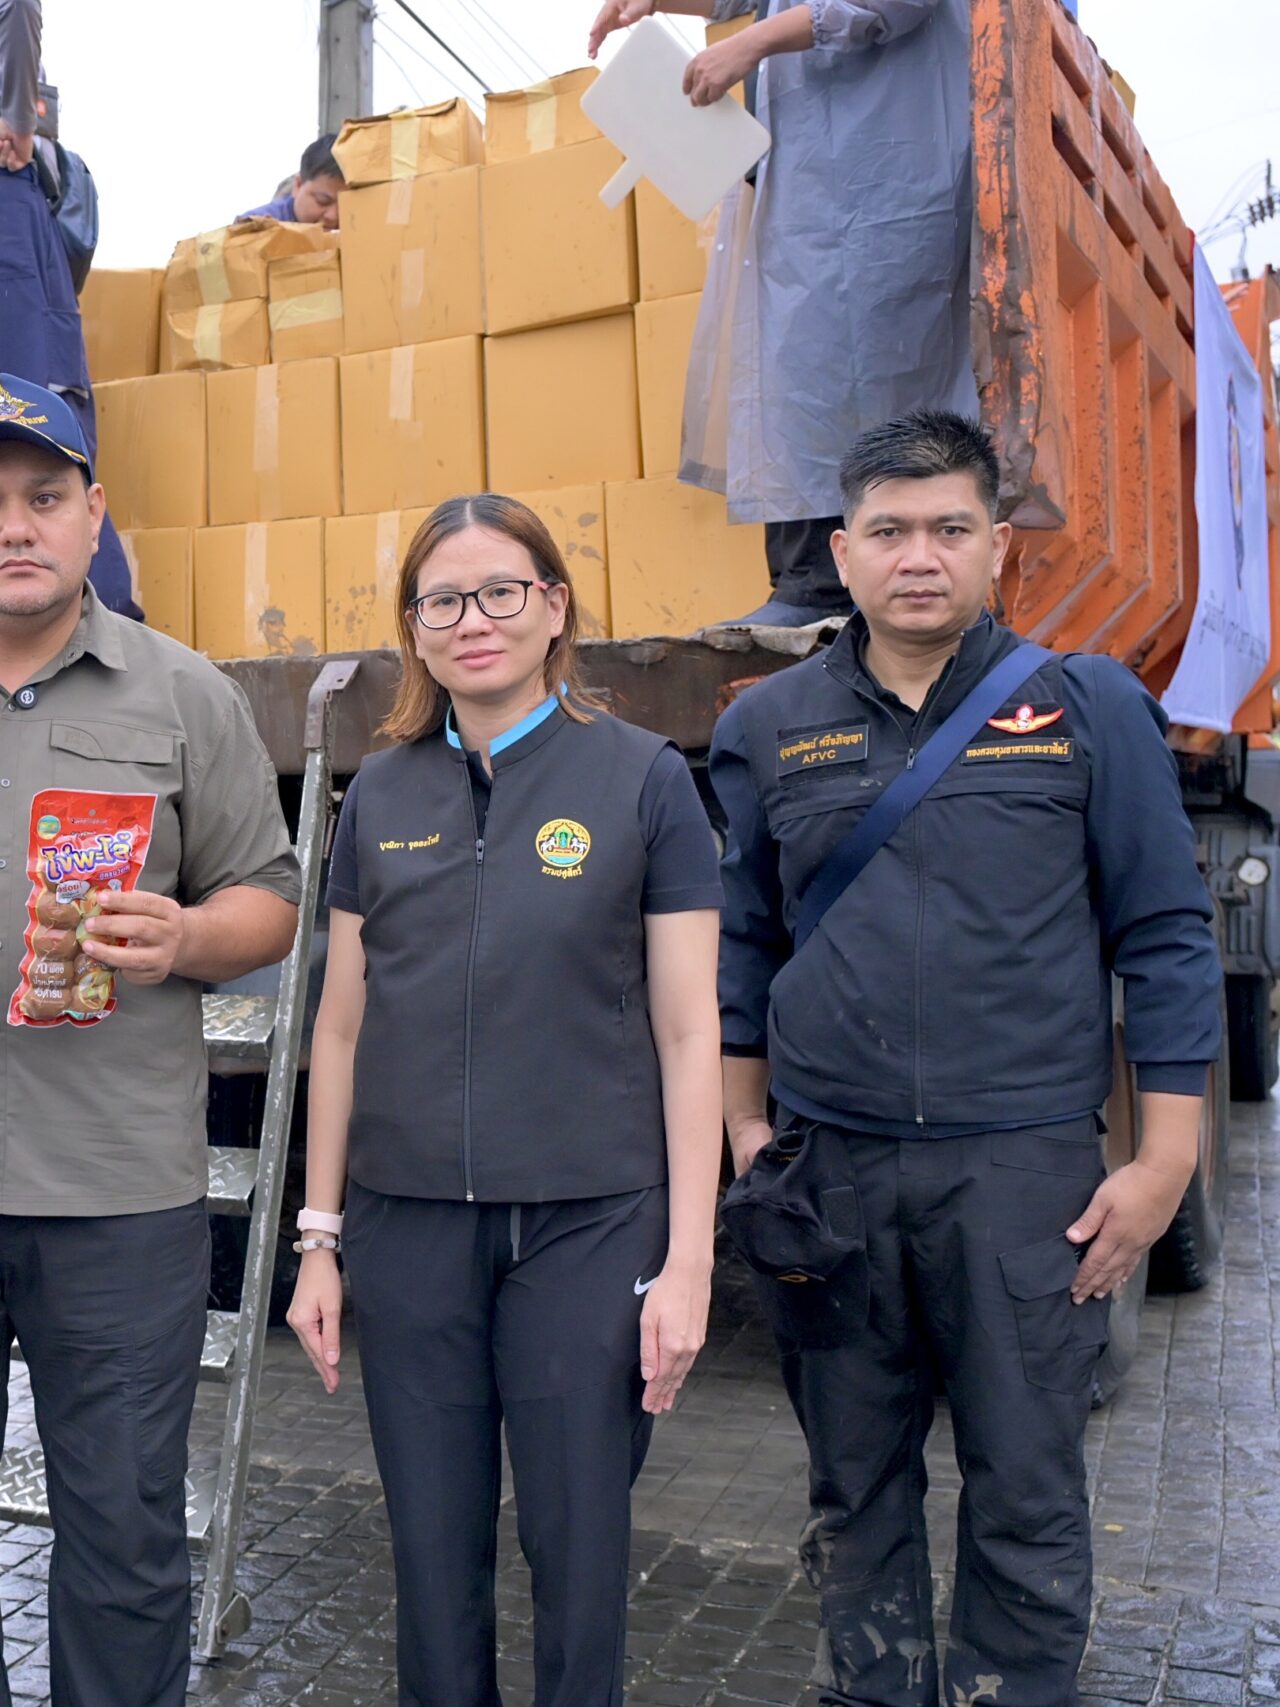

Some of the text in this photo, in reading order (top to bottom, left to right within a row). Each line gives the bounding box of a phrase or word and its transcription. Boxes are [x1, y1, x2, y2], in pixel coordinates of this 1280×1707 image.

[802, 749, 836, 765] AFVC
[41, 831, 132, 881] ไข่พะโล้
